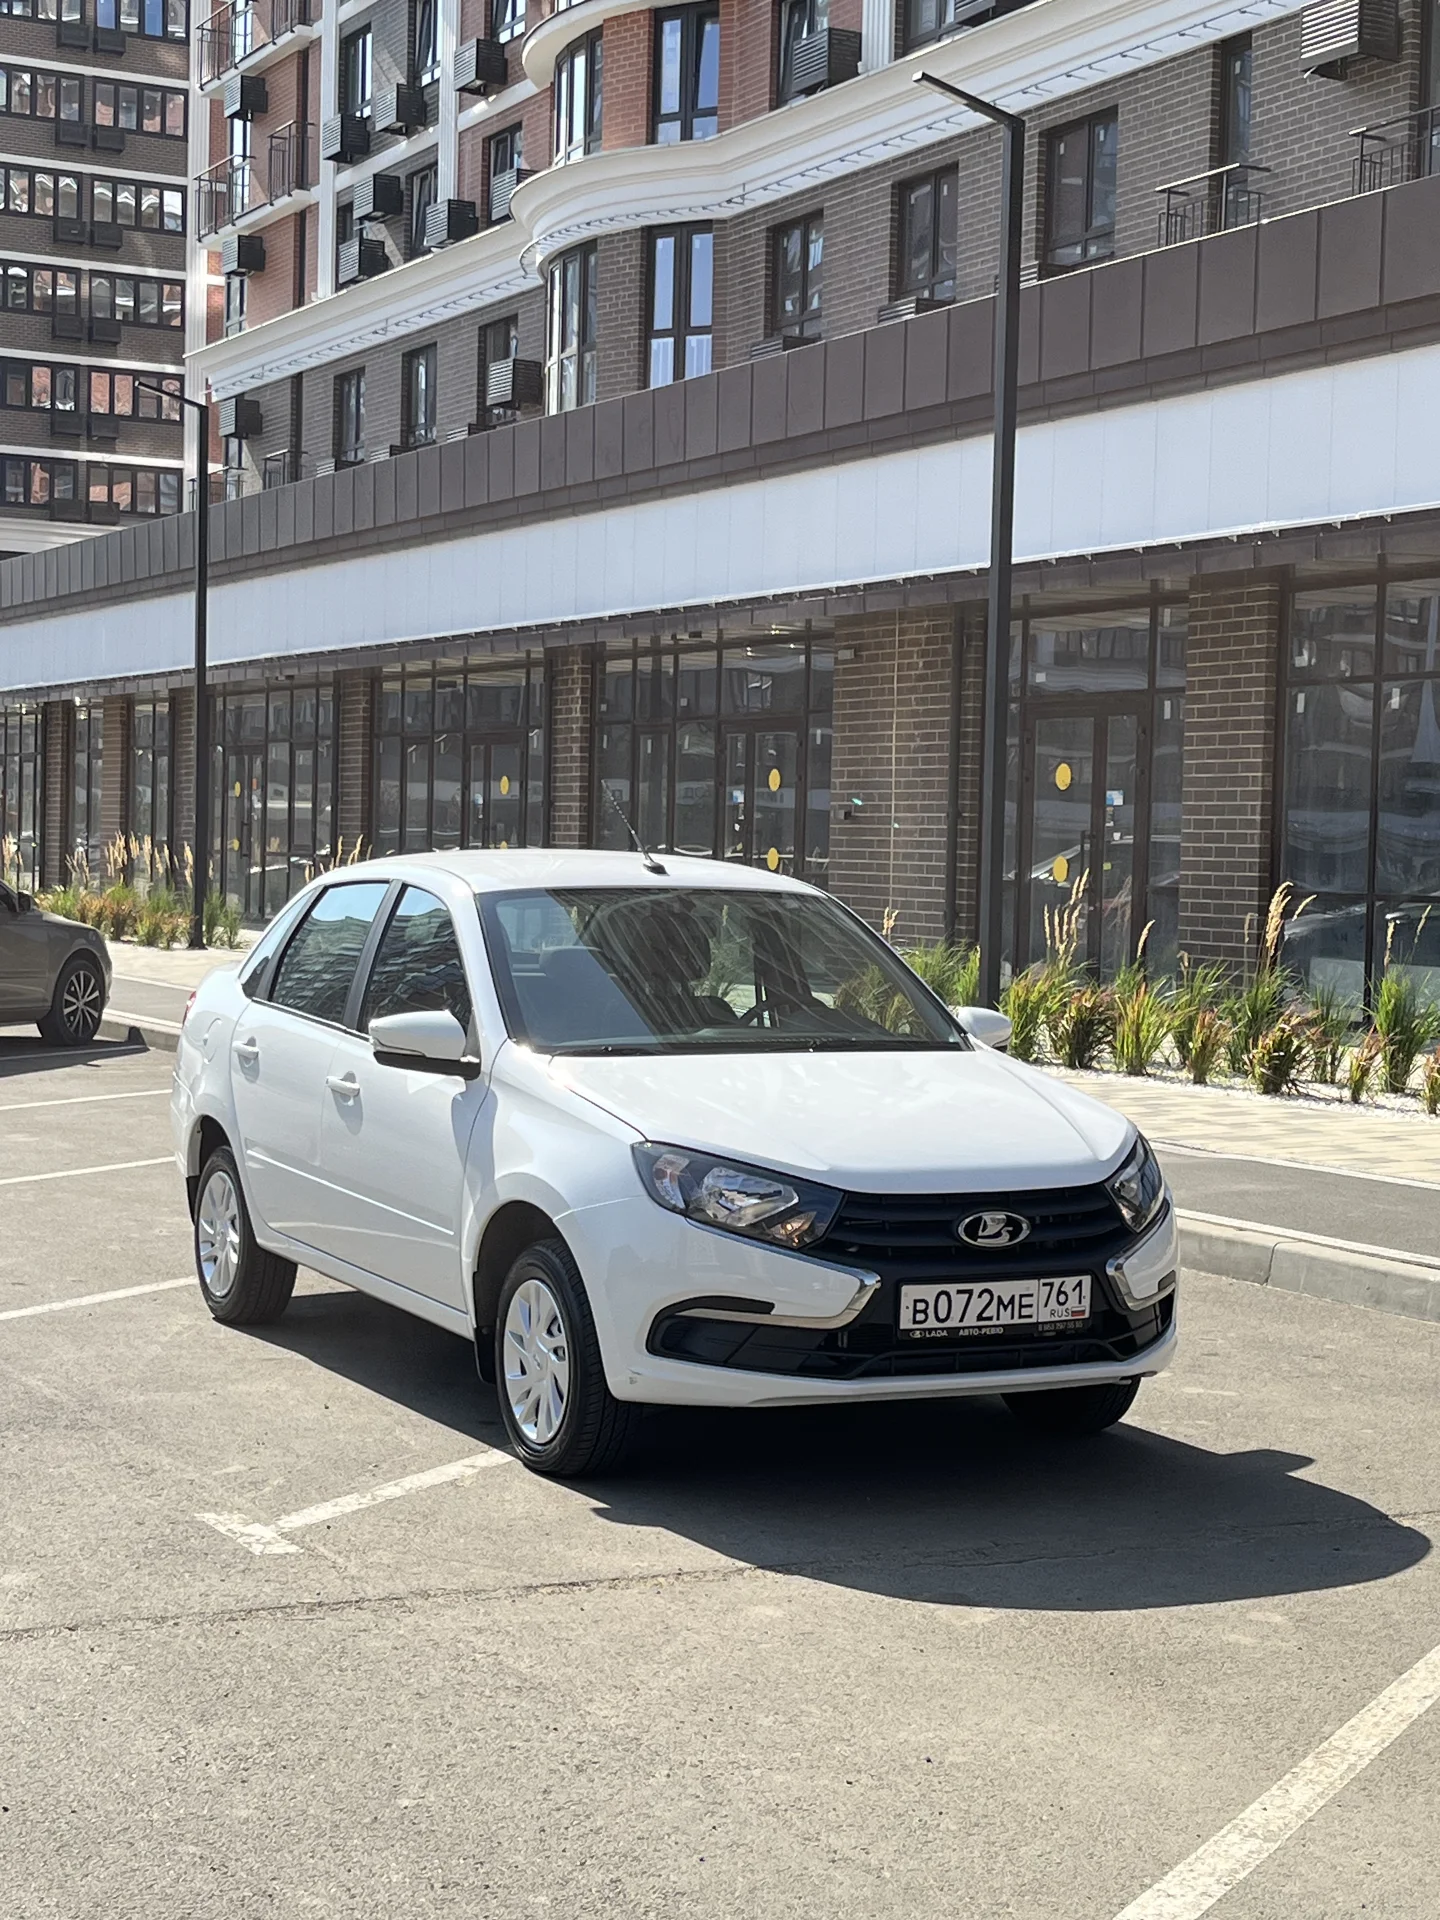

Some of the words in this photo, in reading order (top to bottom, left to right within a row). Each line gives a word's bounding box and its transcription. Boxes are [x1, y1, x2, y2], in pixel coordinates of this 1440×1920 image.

[1042, 1279, 1084, 1308] 761
[1050, 1309, 1070, 1318] RUS
[925, 1329, 948, 1338] LADA
